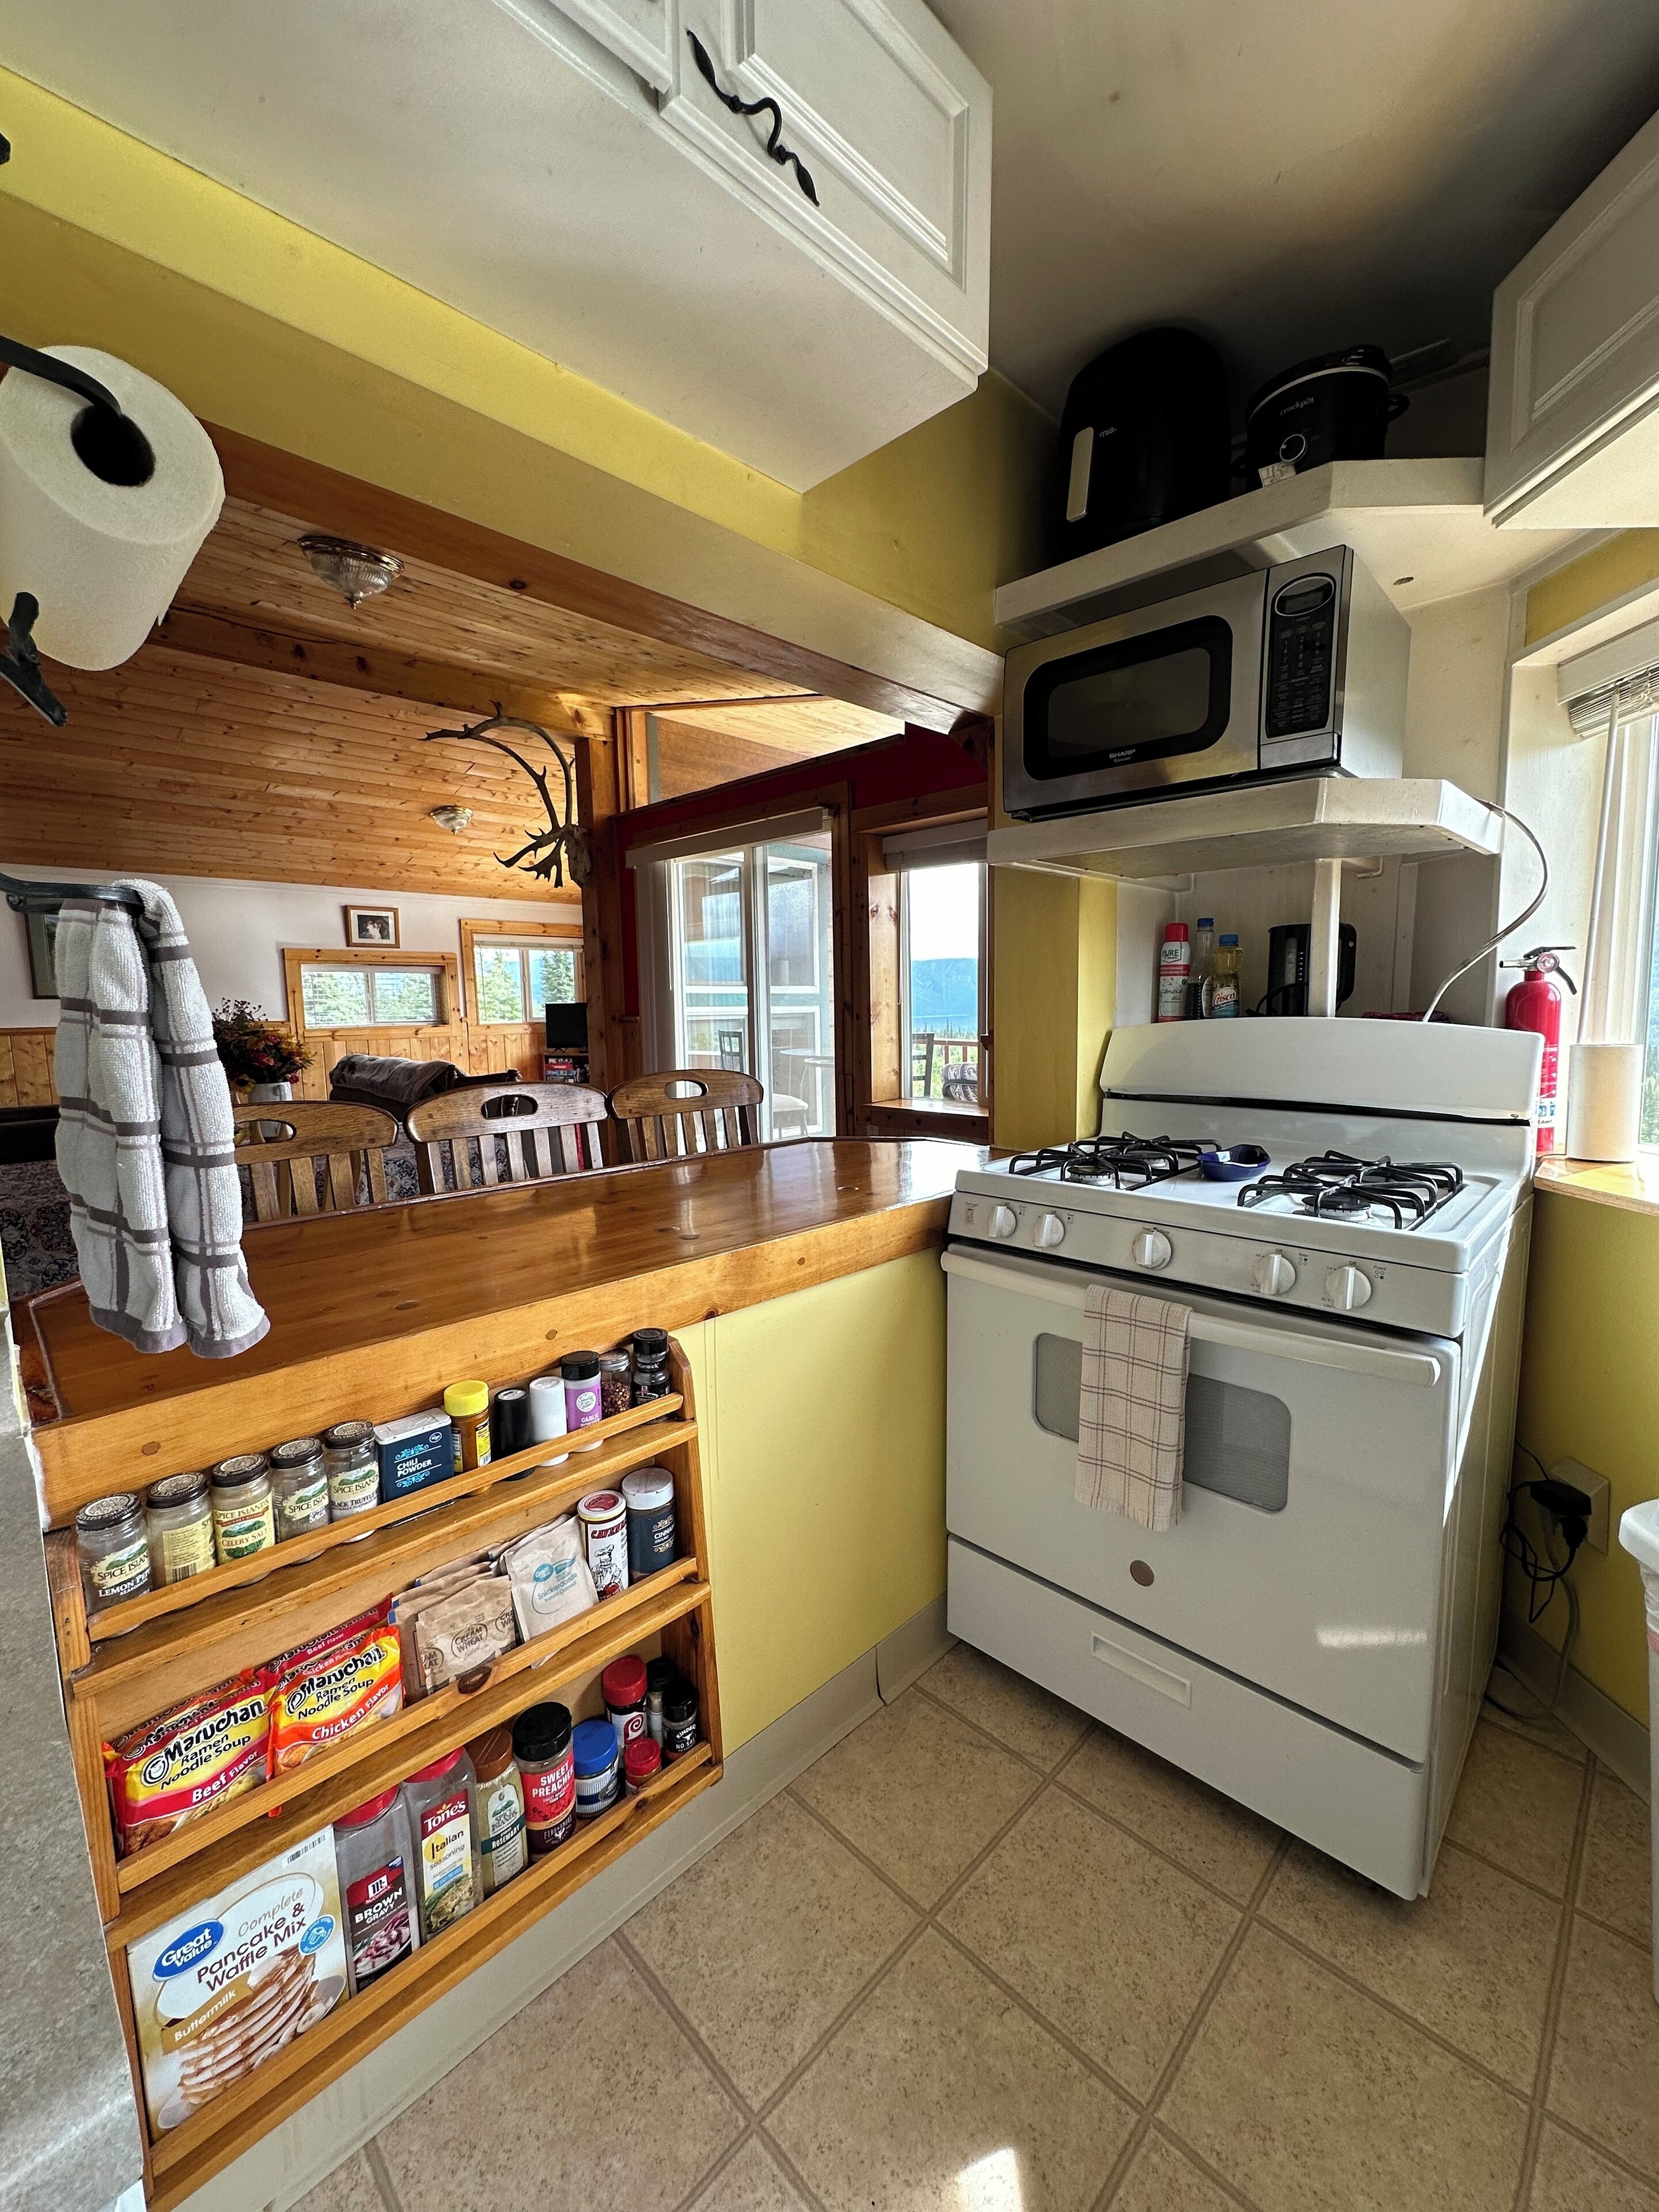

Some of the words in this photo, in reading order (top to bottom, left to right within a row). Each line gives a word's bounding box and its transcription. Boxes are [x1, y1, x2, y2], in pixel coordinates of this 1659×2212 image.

[1109, 749, 1135, 759] SHARP
[1214, 993, 1235, 1006] Crisco
[581, 1412, 599, 1423] GARLIC
[397, 1458, 418, 1471] CHILI
[397, 1459, 433, 1478] POWDER
[333, 1485, 354, 1494] SPICE
[215, 1511, 236, 1519] SPICE
[238, 1499, 269, 1517] ISLANDS
[289, 1501, 312, 1513] SPICE
[222, 1537, 249, 1547] CELERY
[252, 1528, 267, 1540] SALT
[98, 1566, 127, 1581] SPICE
[537, 1573, 577, 1600] Snickerdoodle
[99, 1581, 134, 1597] LEMON
[307, 1642, 325, 1655] Beef
[327, 1633, 344, 1645] Flavor
[455, 1627, 482, 1645] CREAM
[456, 1633, 483, 1653] WHEAT
[301, 1646, 384, 1695] Maruchan
[298, 1694, 341, 1720] Noodle
[343, 1679, 374, 1697] Soup
[316, 1677, 355, 1702] Ramen
[312, 1707, 365, 1740] Chicken
[366, 1683, 390, 1708] Flavor
[164, 1701, 264, 1762] Maruchan
[161, 1753, 212, 1790] Noodle
[215, 1735, 251, 1757] Soup
[181, 1734, 229, 1766] Ramen
[192, 1772, 228, 1804] Beef
[228, 1751, 259, 1777] Flavor
[532, 1764, 574, 1798] PREACHER
[540, 1760, 569, 1786] SWEET
[423, 1800, 466, 1833] Tone's
[491, 1809, 518, 1832] ISLANDS
[495, 1807, 512, 1821] SPICE
[431, 1831, 464, 1859] Italian
[491, 1823, 520, 1850] ROSEMARY
[430, 1843, 465, 1870] seasoning
[238, 1887, 303, 1938] Complete
[355, 1887, 402, 1923] BROWN
[366, 1901, 395, 1923] GRAVY
[161, 1927, 212, 1967] Great
[175, 1938, 213, 1968] Value
[196, 1916, 287, 1984] Pancake
[292, 1902, 305, 1918] &
[206, 1946, 268, 1992] Waffle
[272, 1917, 306, 1949] Mix
[174, 1988, 236, 2042] Buttermilk
